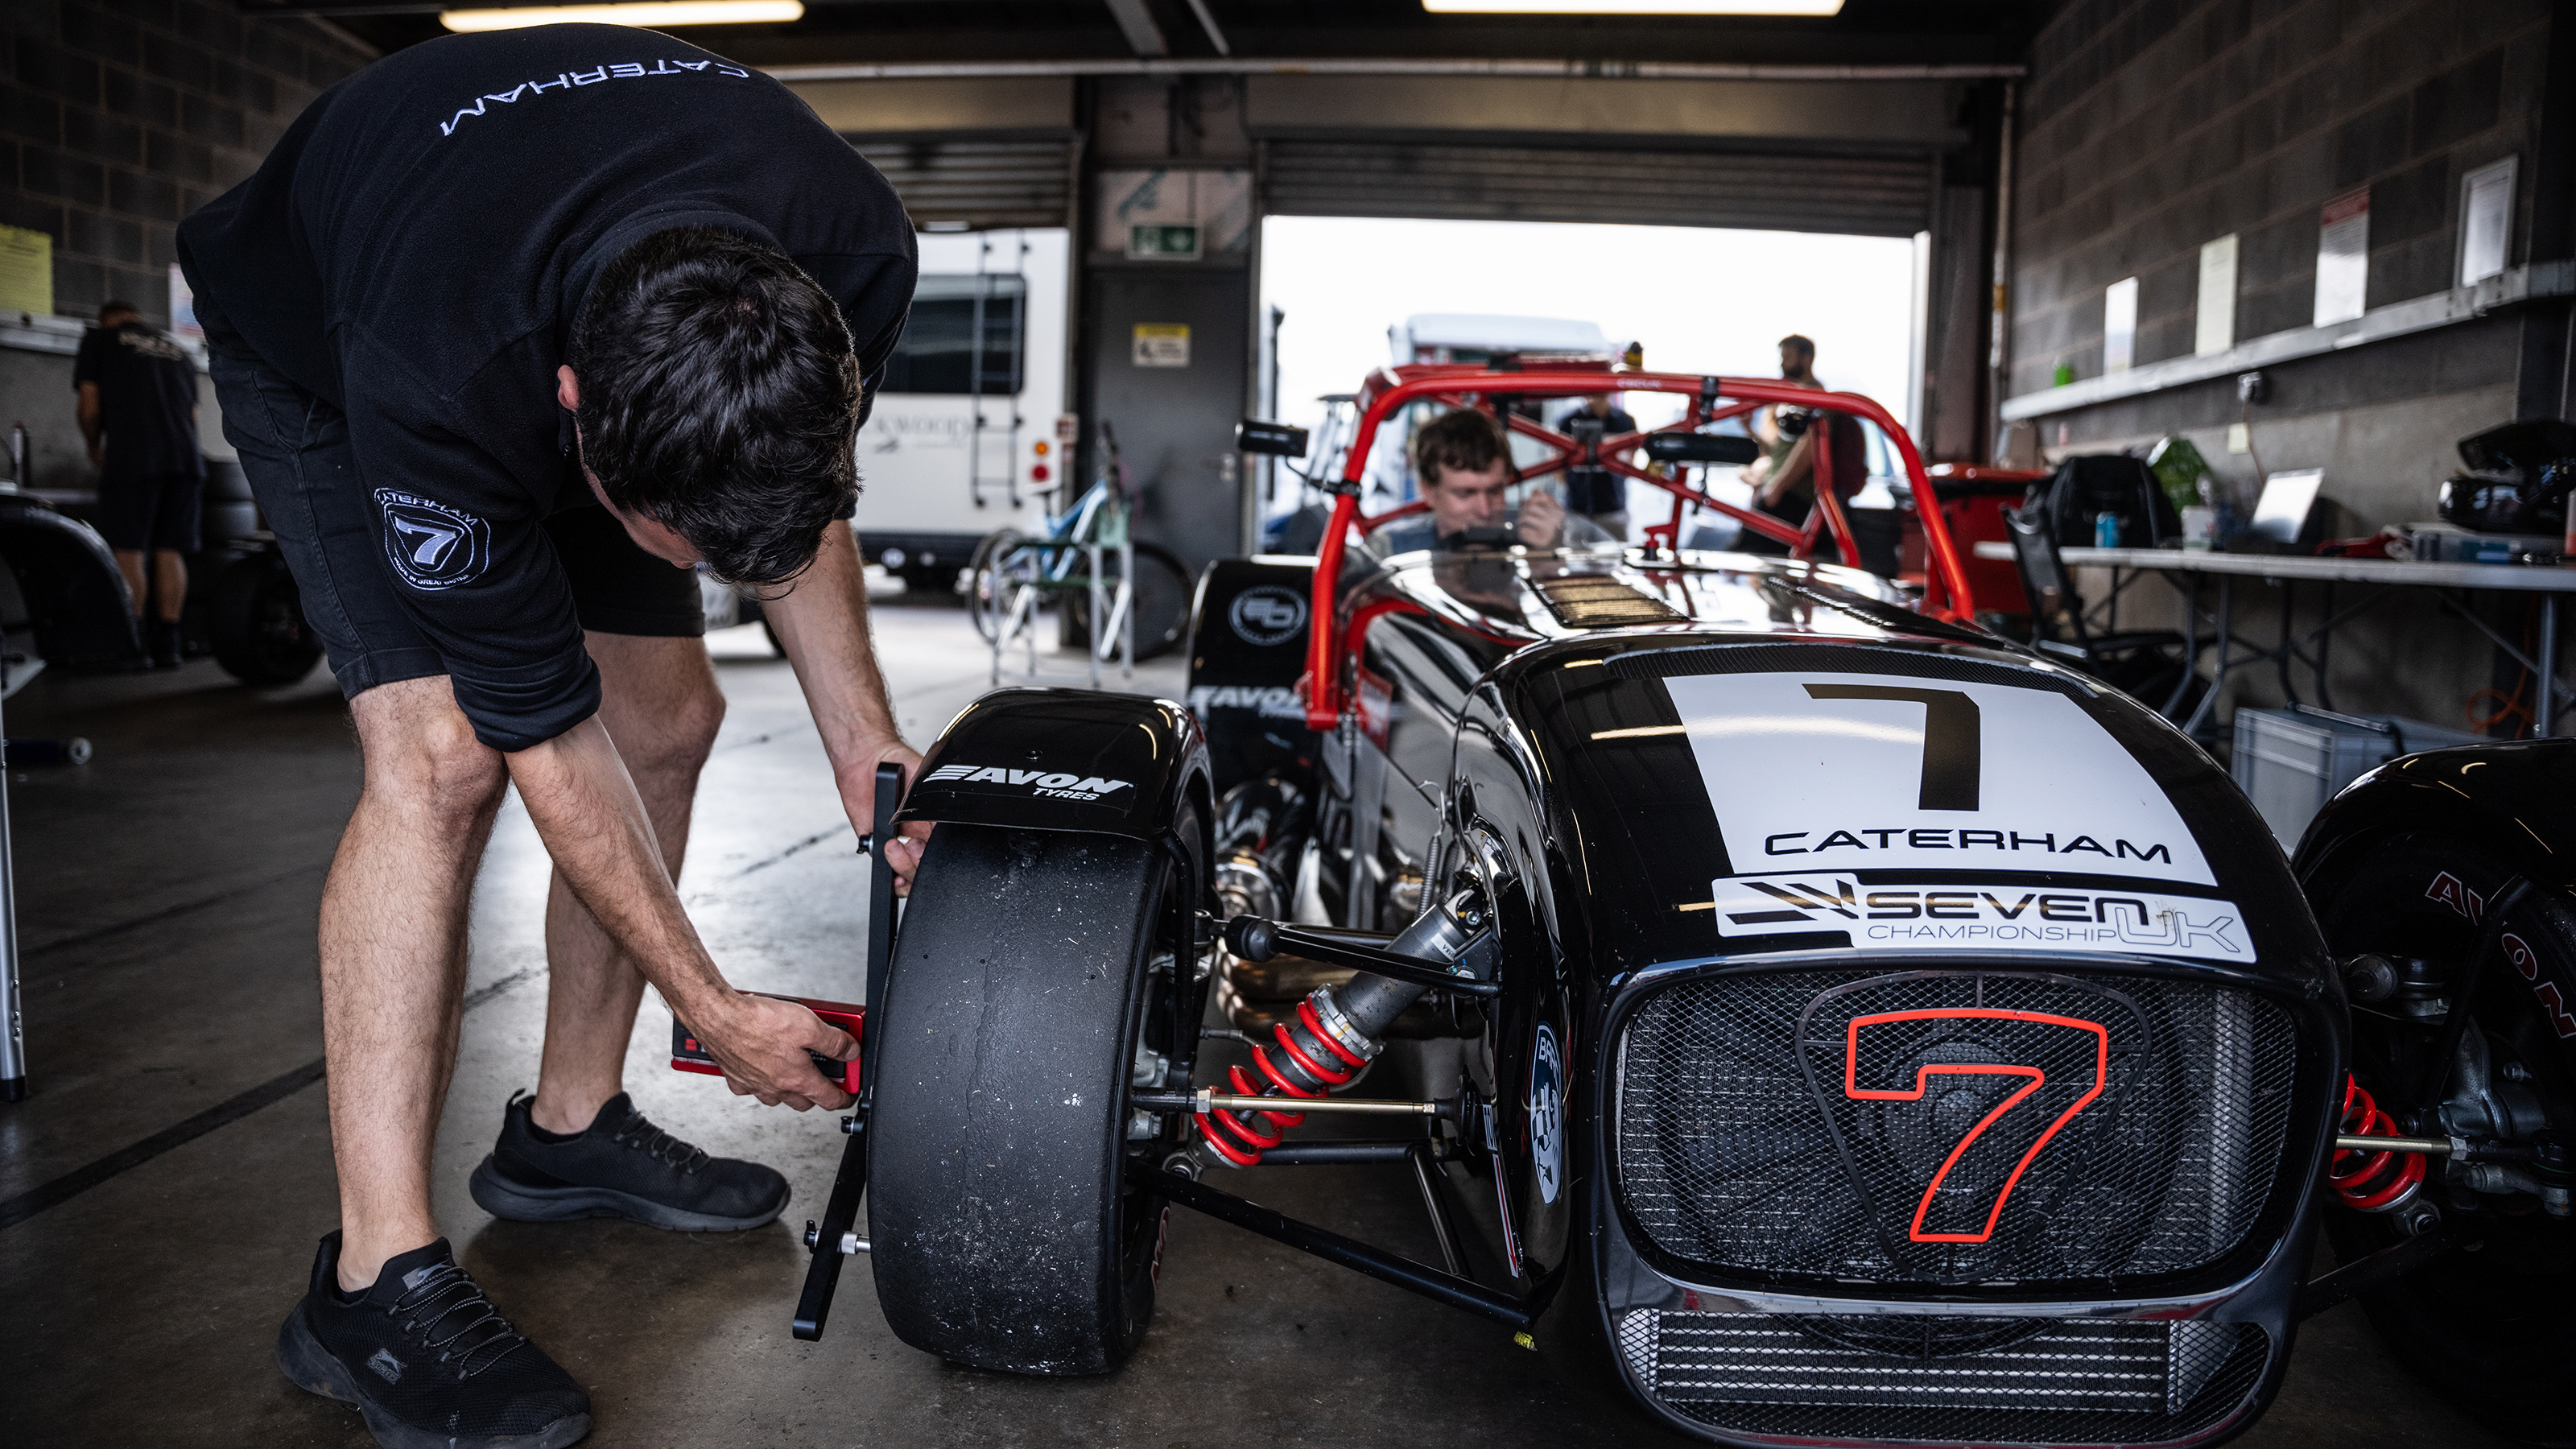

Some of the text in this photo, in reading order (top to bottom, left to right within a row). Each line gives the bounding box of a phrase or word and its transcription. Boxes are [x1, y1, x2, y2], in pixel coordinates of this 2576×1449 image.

[440, 60, 749, 137] CATERHAM
[378, 492, 479, 526] CATERHAM
[394, 515, 457, 566] 7
[394, 556, 409, 576] MADE
[409, 574, 417, 583] IN
[1802, 683, 1981, 812] 7
[964, 766, 1129, 794] AVON
[1033, 787, 1100, 801] TYRES
[1765, 828, 2172, 865] CATERHAM
[1866, 891, 2240, 953] SEVEN UK
[1868, 924, 2116, 942] CHAMPIONSHIP
[1845, 1006, 2107, 1244] 7
